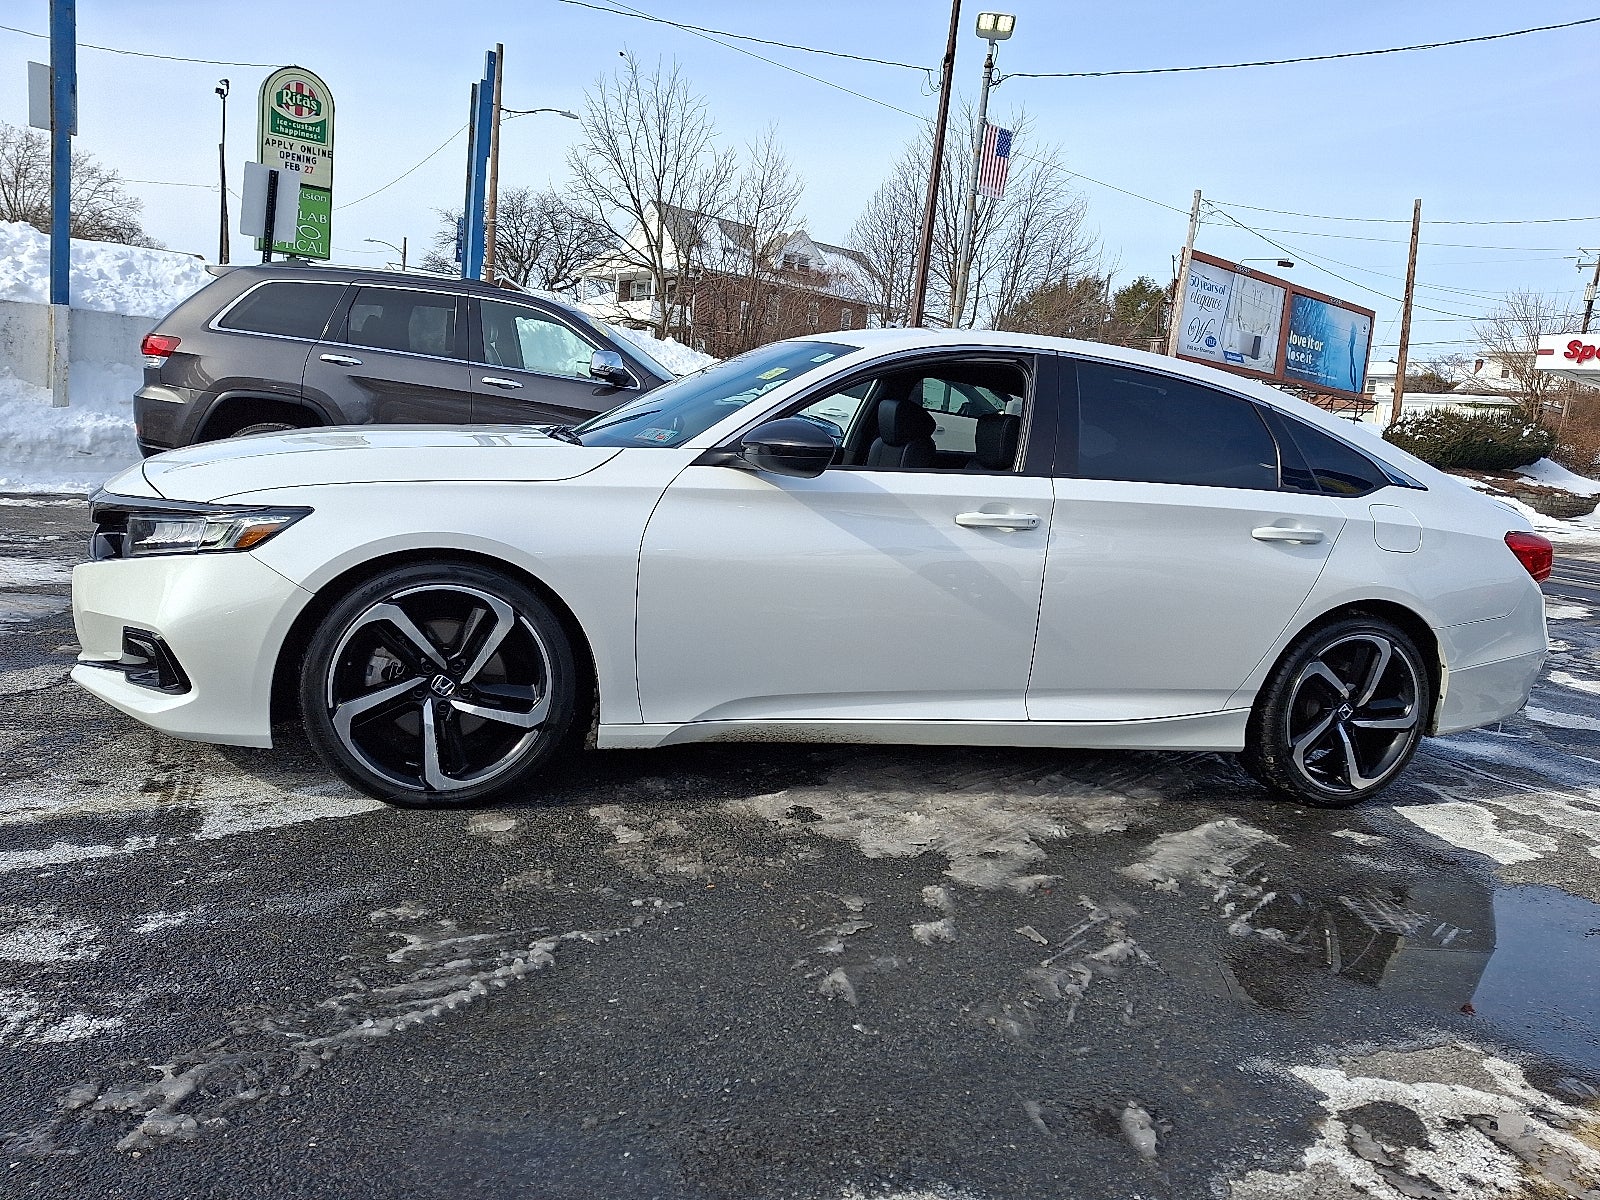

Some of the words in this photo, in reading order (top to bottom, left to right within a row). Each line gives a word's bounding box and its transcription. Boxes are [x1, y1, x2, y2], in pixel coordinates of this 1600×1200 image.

[282, 89, 318, 111] Rita's
[292, 122, 320, 133] custard
[265, 138, 294, 151] APPLY
[300, 144, 333, 159] ONLINE
[280, 150, 317, 165] OPENING
[284, 161, 300, 172] FEB
[304, 165, 314, 174] 27
[299, 190, 327, 203] ision
[299, 210, 327, 224] LAB
[272, 239, 326, 255] PTICAL
[1189, 275, 1200, 288] 50
[1200, 280, 1218, 294] years
[1218, 284, 1227, 296] of
[1190, 287, 1223, 313] elegance
[1289, 330, 1307, 347] love
[1307, 334, 1315, 350] it
[1314, 341, 1324, 352] or
[1287, 347, 1306, 362] lose
[1305, 350, 1313, 364] it
